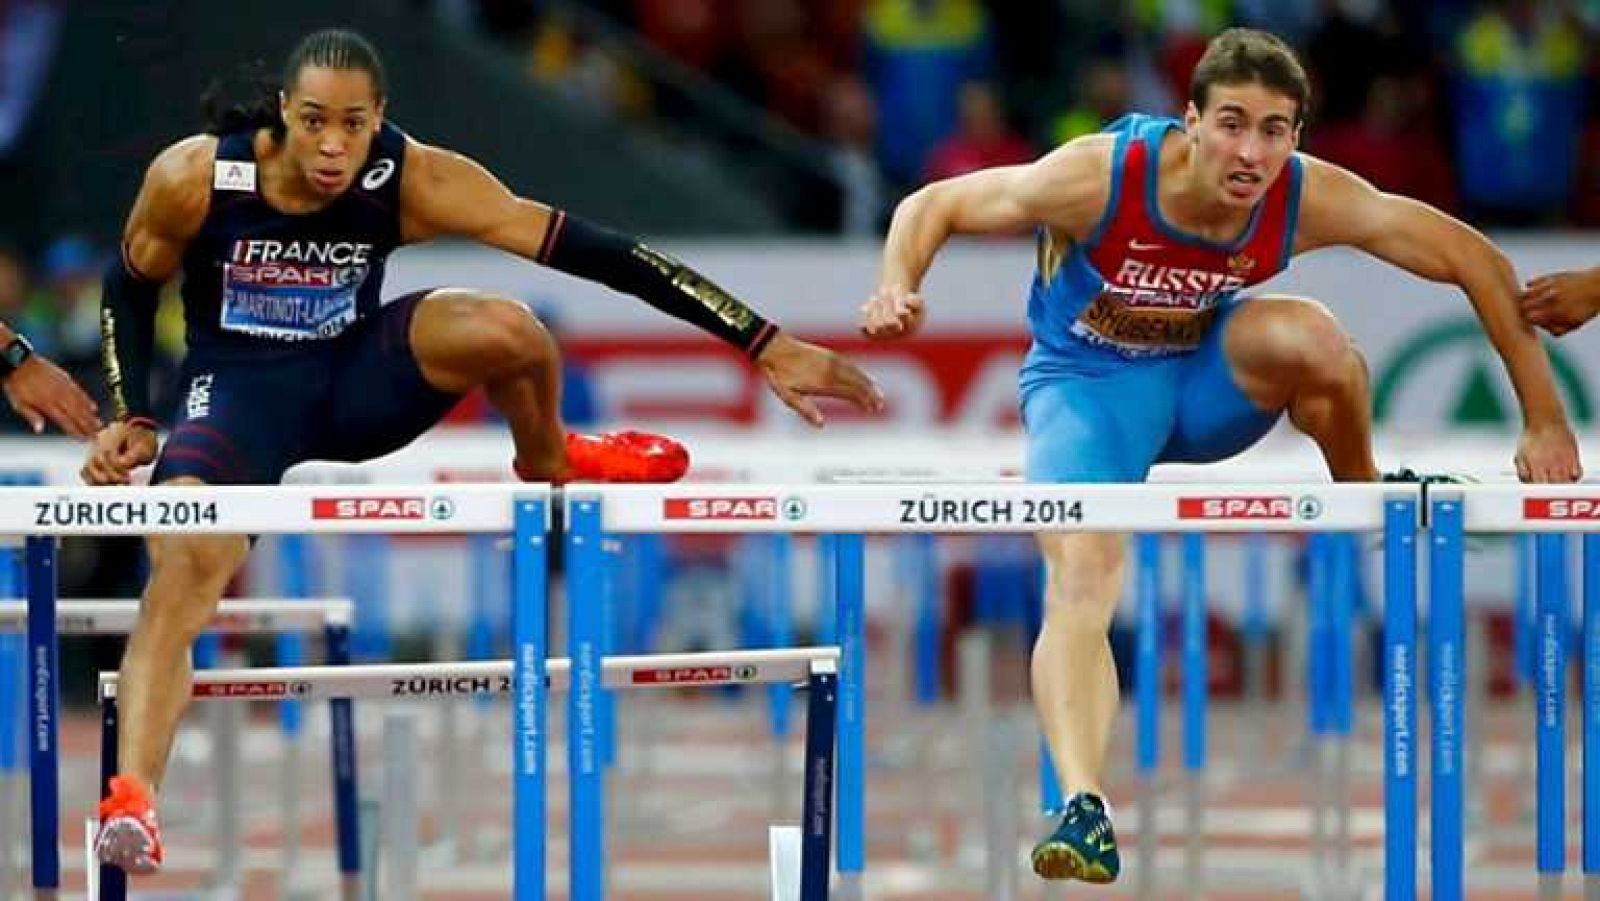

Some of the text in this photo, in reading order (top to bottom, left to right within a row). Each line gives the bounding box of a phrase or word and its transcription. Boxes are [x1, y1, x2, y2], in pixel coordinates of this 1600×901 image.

[245, 239, 373, 264] FRANCE
[231, 265, 332, 284] SPAR
[34, 497, 219, 525] ZÜRICH 2014
[335, 498, 424, 519] SPAR
[688, 498, 776, 519] SPAR
[900, 496, 1084, 523] ZÜRICH 2014
[1203, 498, 1291, 518] SPAR
[391, 674, 490, 696] ZÜRICH
[654, 667, 730, 682] SPAR
[208, 682, 286, 696] SPAR
[521, 643, 539, 775] nordicsport.com
[577, 642, 594, 774] nordicsport.com
[1391, 643, 1409, 776] nordicsport.com
[1438, 642, 1458, 775] nordicsport.com
